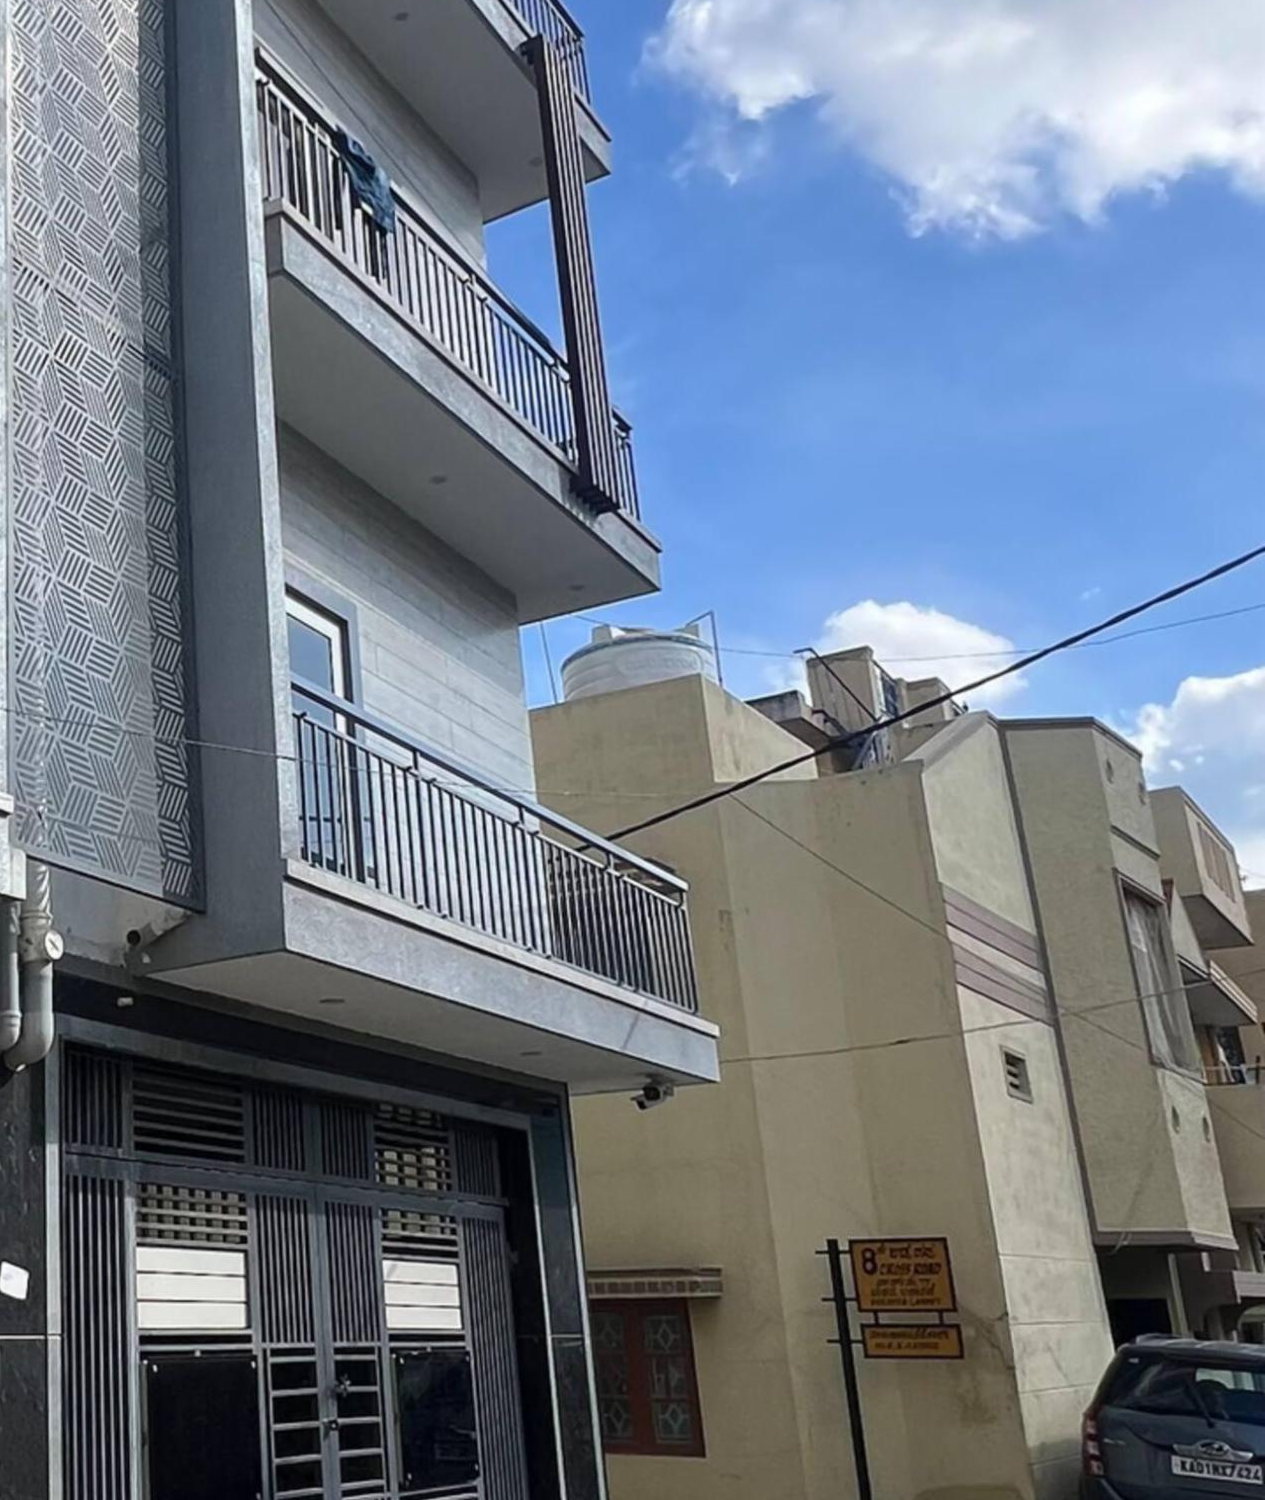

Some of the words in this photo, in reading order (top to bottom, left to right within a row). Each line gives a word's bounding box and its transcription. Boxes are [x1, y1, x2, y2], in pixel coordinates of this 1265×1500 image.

[861, 1247, 878, 1275] 8
[879, 1263, 911, 1275] CROSS
[914, 1262, 942, 1275] ROAD
